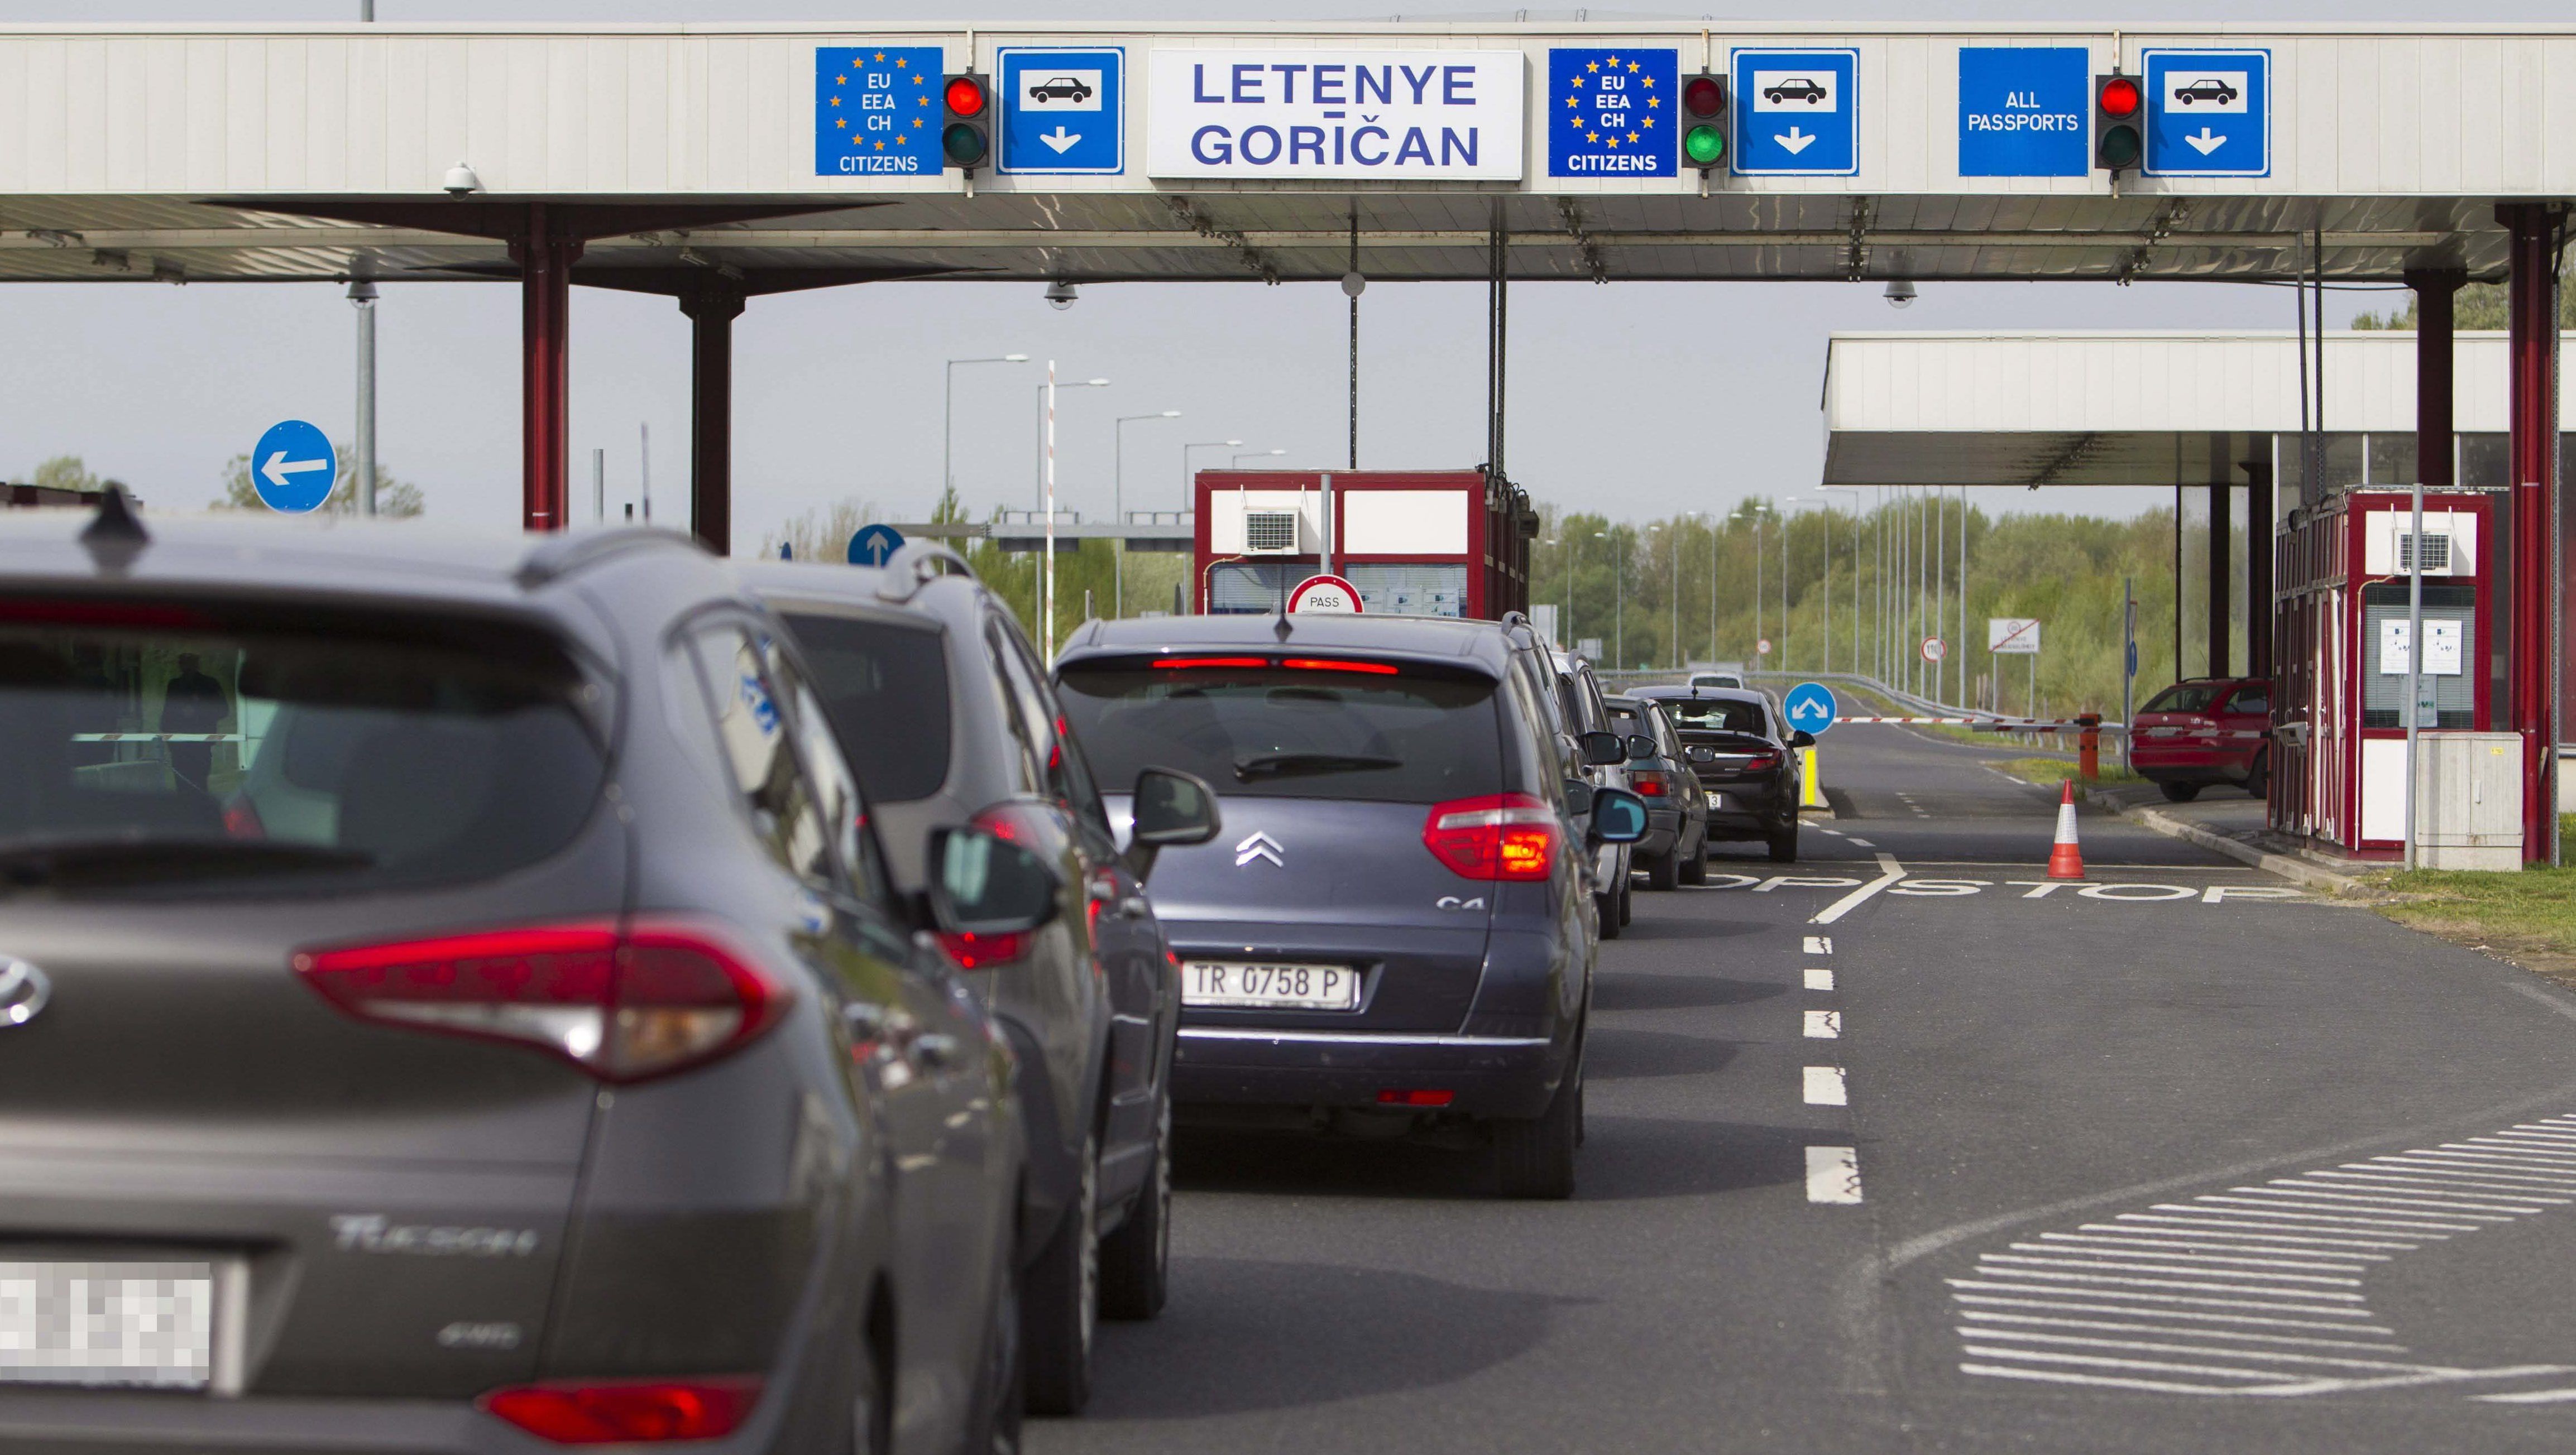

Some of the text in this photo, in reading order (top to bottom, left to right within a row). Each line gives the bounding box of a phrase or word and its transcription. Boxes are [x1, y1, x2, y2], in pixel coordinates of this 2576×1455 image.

[868, 73, 890, 89] EU
[1194, 64, 1476, 105] LETENYE
[1602, 76, 1625, 90] EU
[862, 94, 896, 109] EEA
[1596, 94, 1631, 109] EEA
[2005, 92, 2041, 108] ALL
[868, 115, 890, 131] CH
[1601, 113, 1625, 127] CH
[1969, 114, 2078, 131] PASSPORTS
[840, 156, 918, 172] CITIZENS
[1568, 155, 1657, 171] CITIZENS
[1310, 597, 1339, 607] PASS
[1886, 878, 2304, 902] STOP
[1436, 896, 1485, 909] C4
[1194, 964, 1338, 997] TR 0758 P
